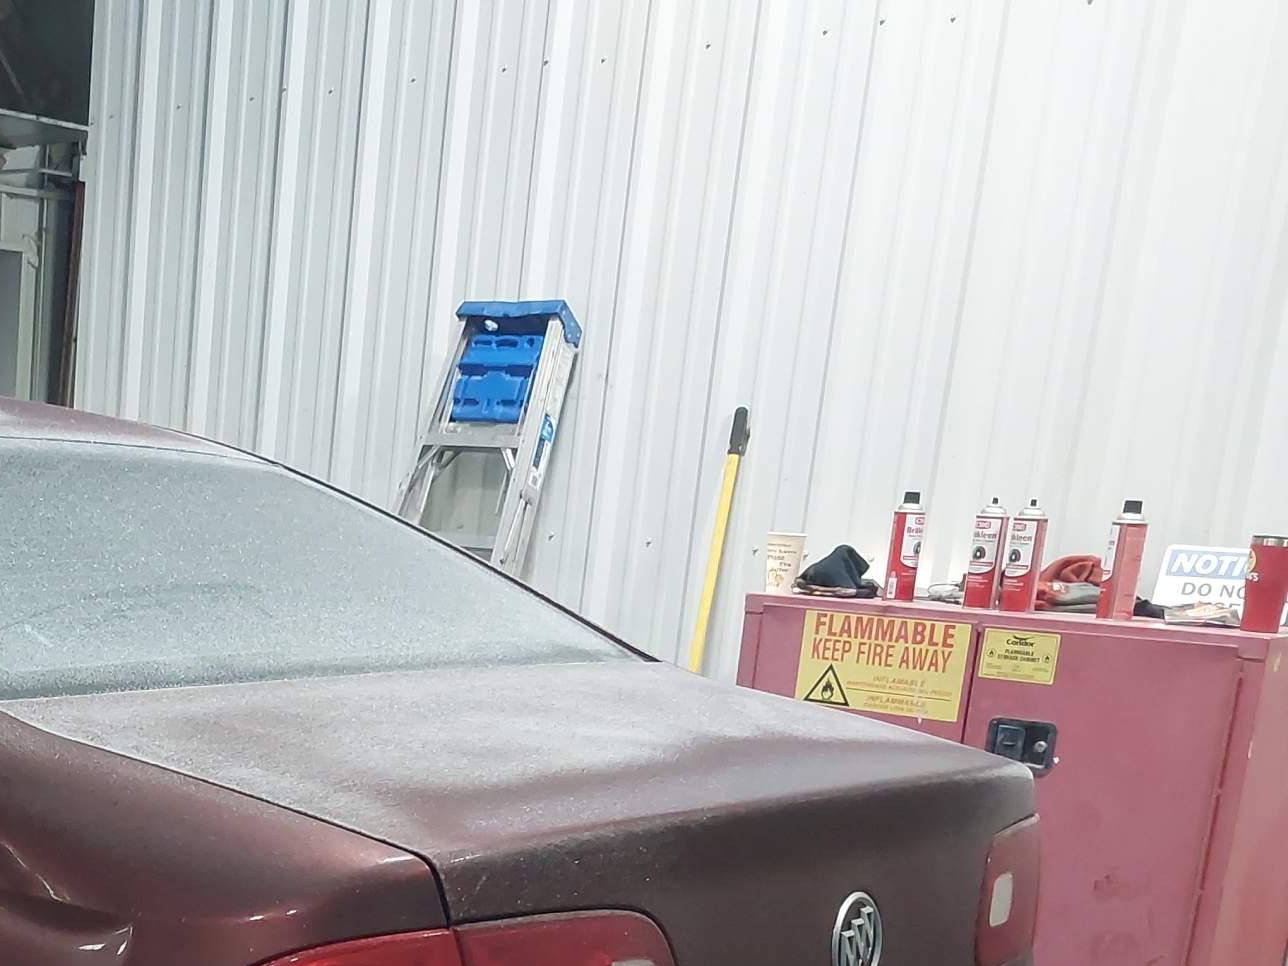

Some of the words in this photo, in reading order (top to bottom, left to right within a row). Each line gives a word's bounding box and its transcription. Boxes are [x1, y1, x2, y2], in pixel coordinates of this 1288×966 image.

[1181, 582, 1212, 597] DO
[814, 613, 957, 649] FLAMMABLE
[811, 638, 852, 662] KEEP
[856, 642, 895, 668] FIRE
[898, 646, 953, 674] AWAY
